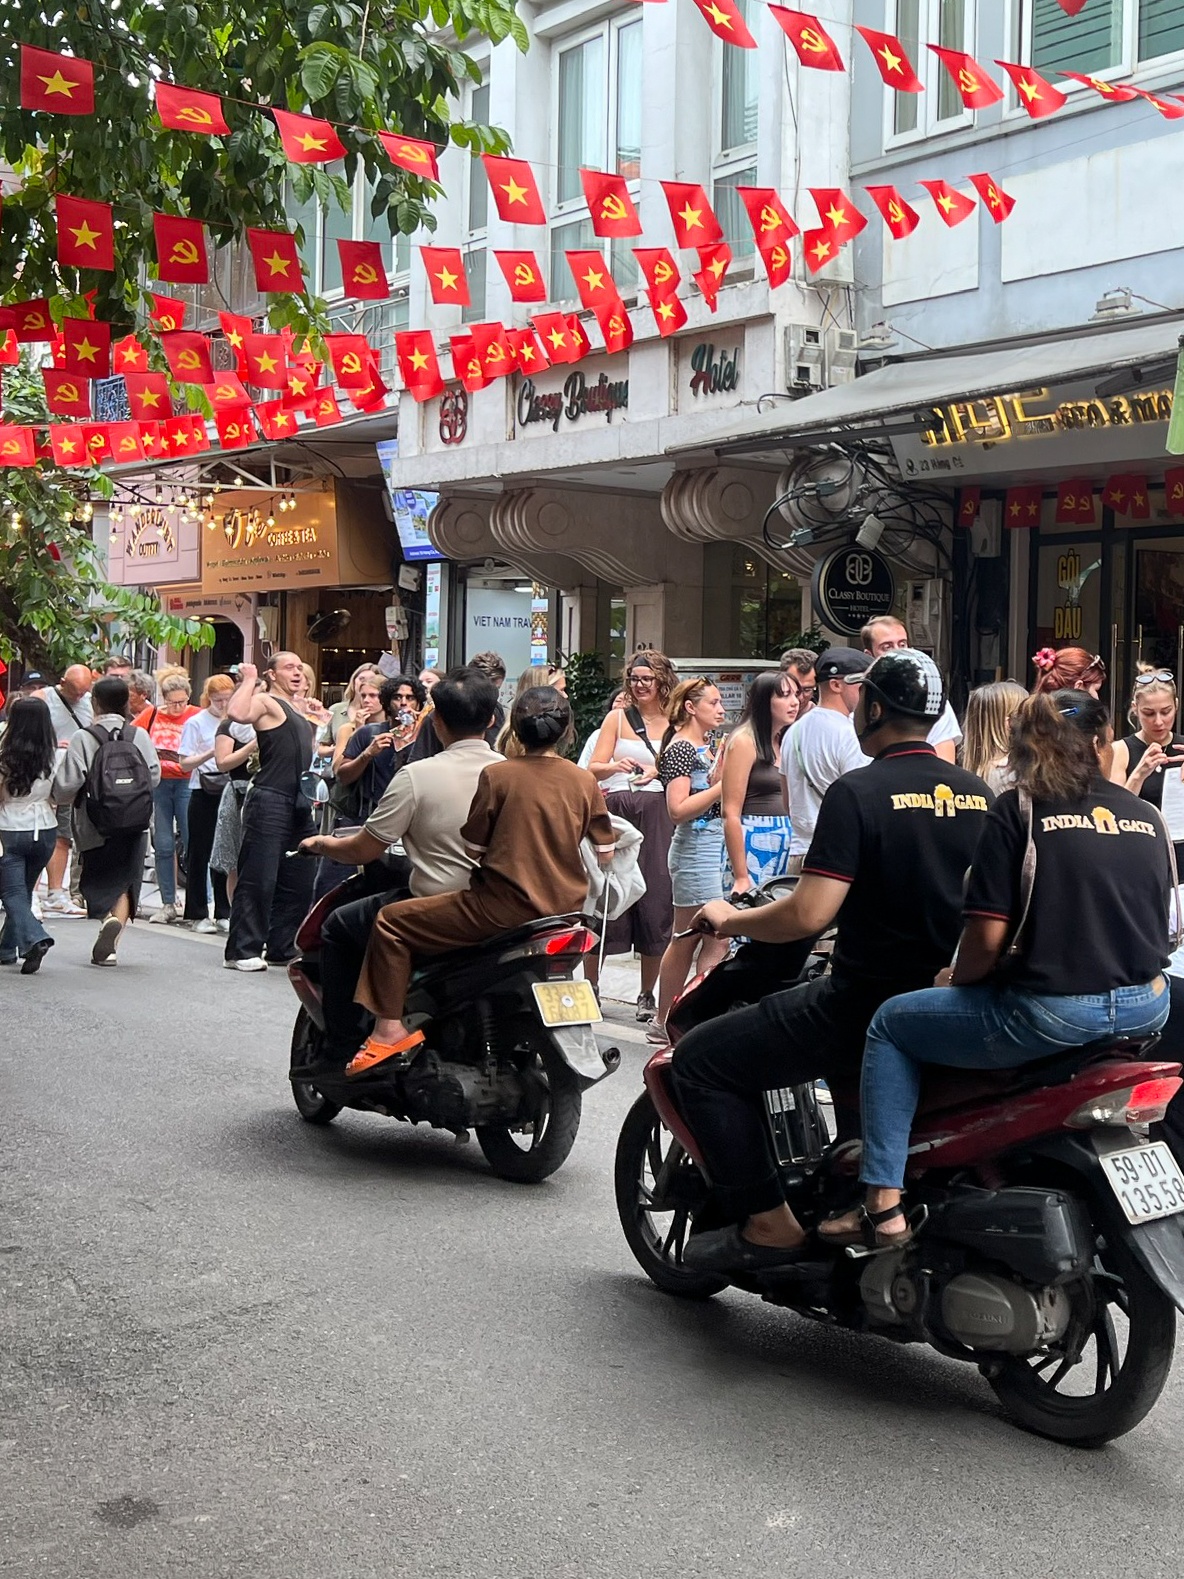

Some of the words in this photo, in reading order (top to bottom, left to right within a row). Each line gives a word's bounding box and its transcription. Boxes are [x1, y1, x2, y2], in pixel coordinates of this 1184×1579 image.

[690, 343, 740, 397] Hotel
[850, 604, 870, 612] HOTEL
[473, 615, 492, 627] VIET
[493, 616, 512, 627] NAM
[891, 793, 935, 810] INDIA
[955, 794, 988, 811] GATE
[1041, 815, 1095, 833] INDIA
[1118, 819, 1157, 838] GATE
